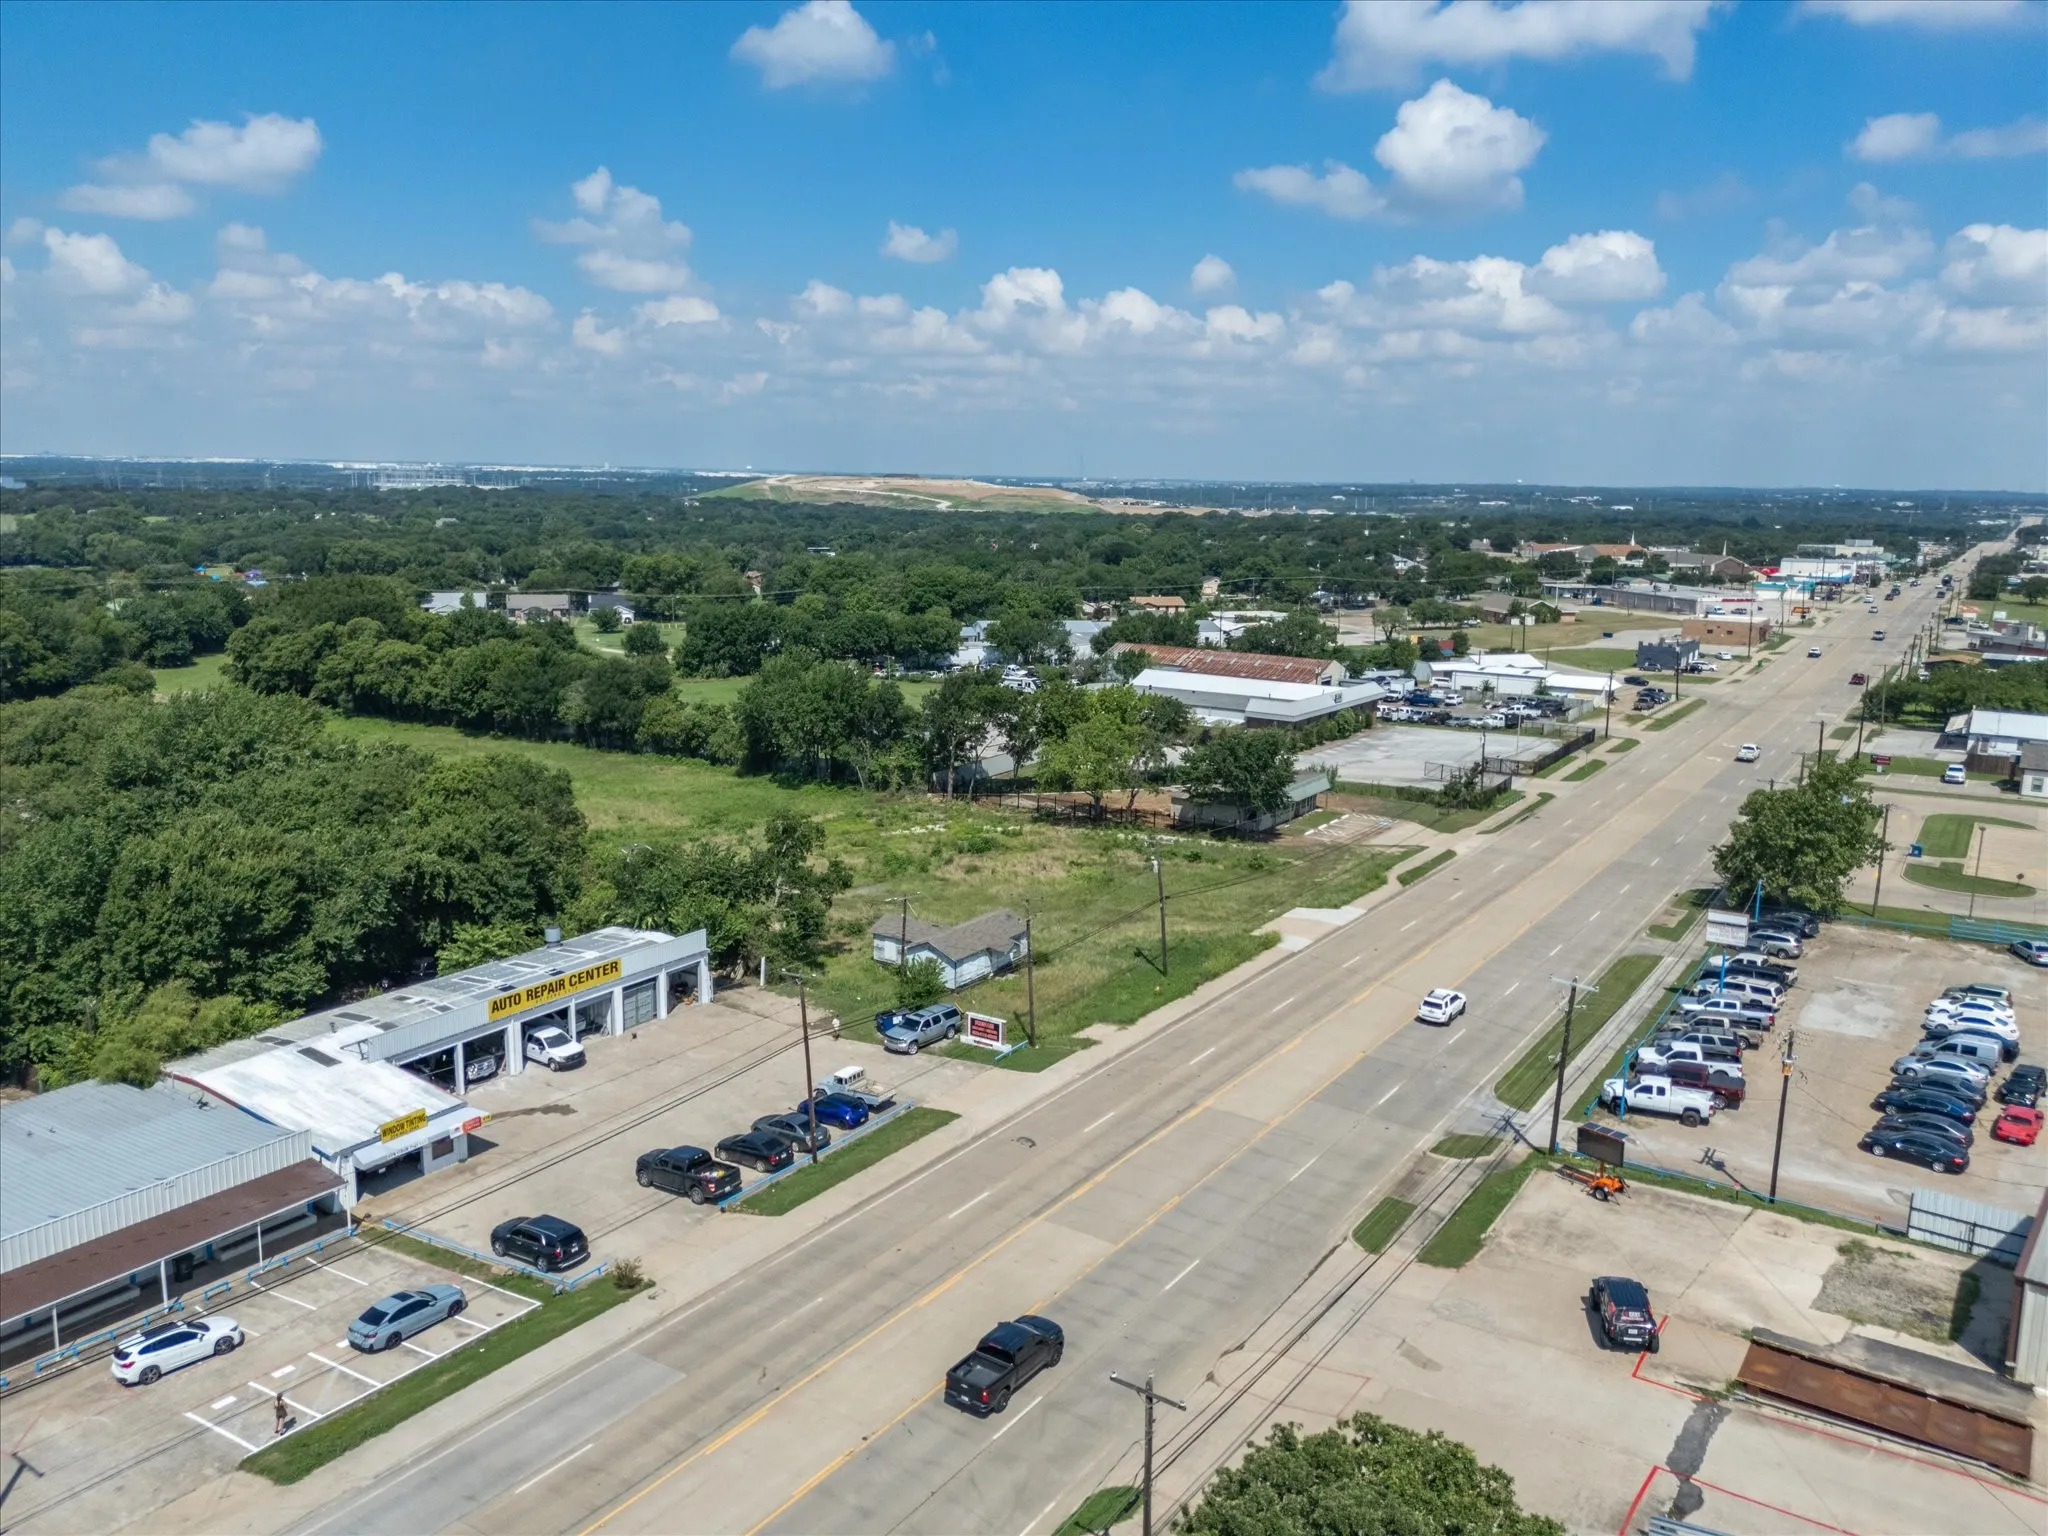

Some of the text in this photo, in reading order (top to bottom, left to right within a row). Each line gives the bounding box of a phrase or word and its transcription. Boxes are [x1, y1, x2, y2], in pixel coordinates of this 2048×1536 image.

[491, 993, 522, 1014] AUTO
[526, 979, 566, 1002] REPAIR
[569, 961, 619, 987] CENTER
[382, 1122, 405, 1137] WINDOW
[405, 1112, 426, 1129] TINTING
